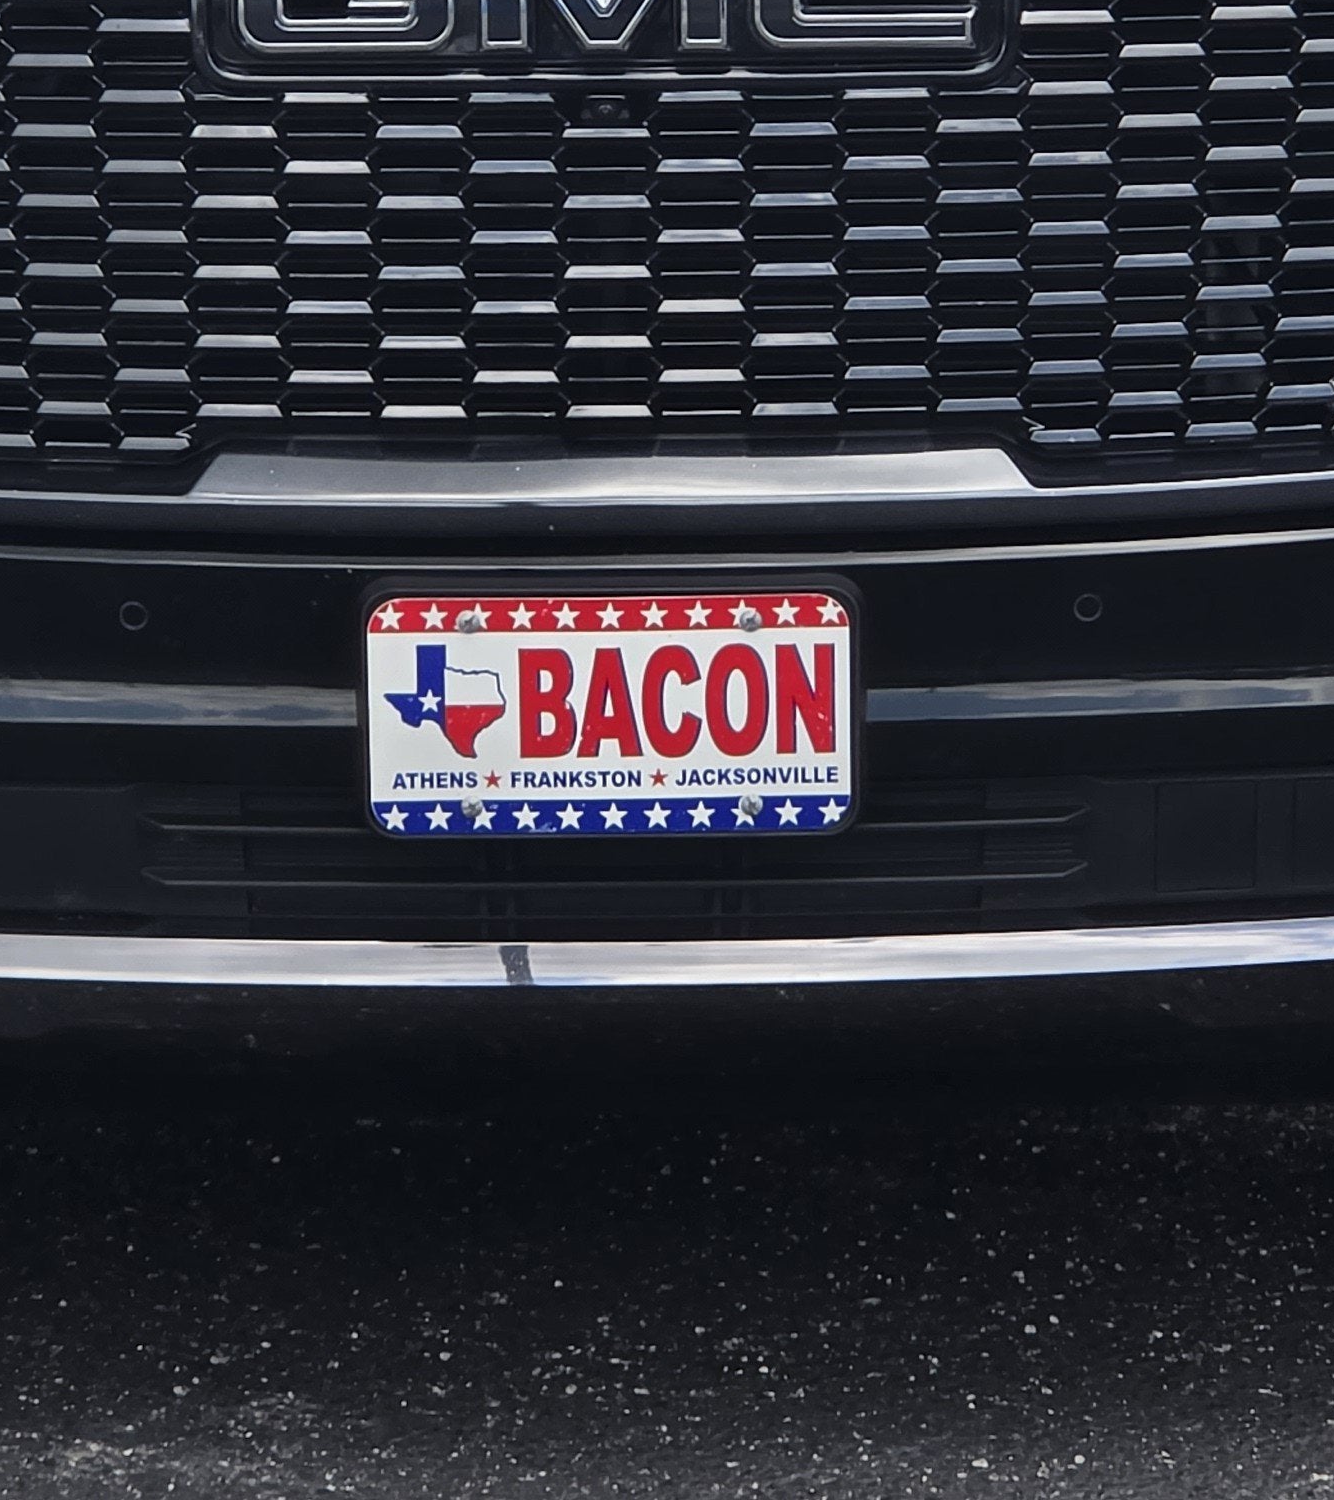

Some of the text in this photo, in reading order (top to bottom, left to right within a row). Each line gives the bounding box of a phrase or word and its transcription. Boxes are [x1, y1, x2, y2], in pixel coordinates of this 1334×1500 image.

[518, 643, 837, 758] BACON
[392, 765, 839, 789] ATHENS FRANKSTON JACKSONVILLE
